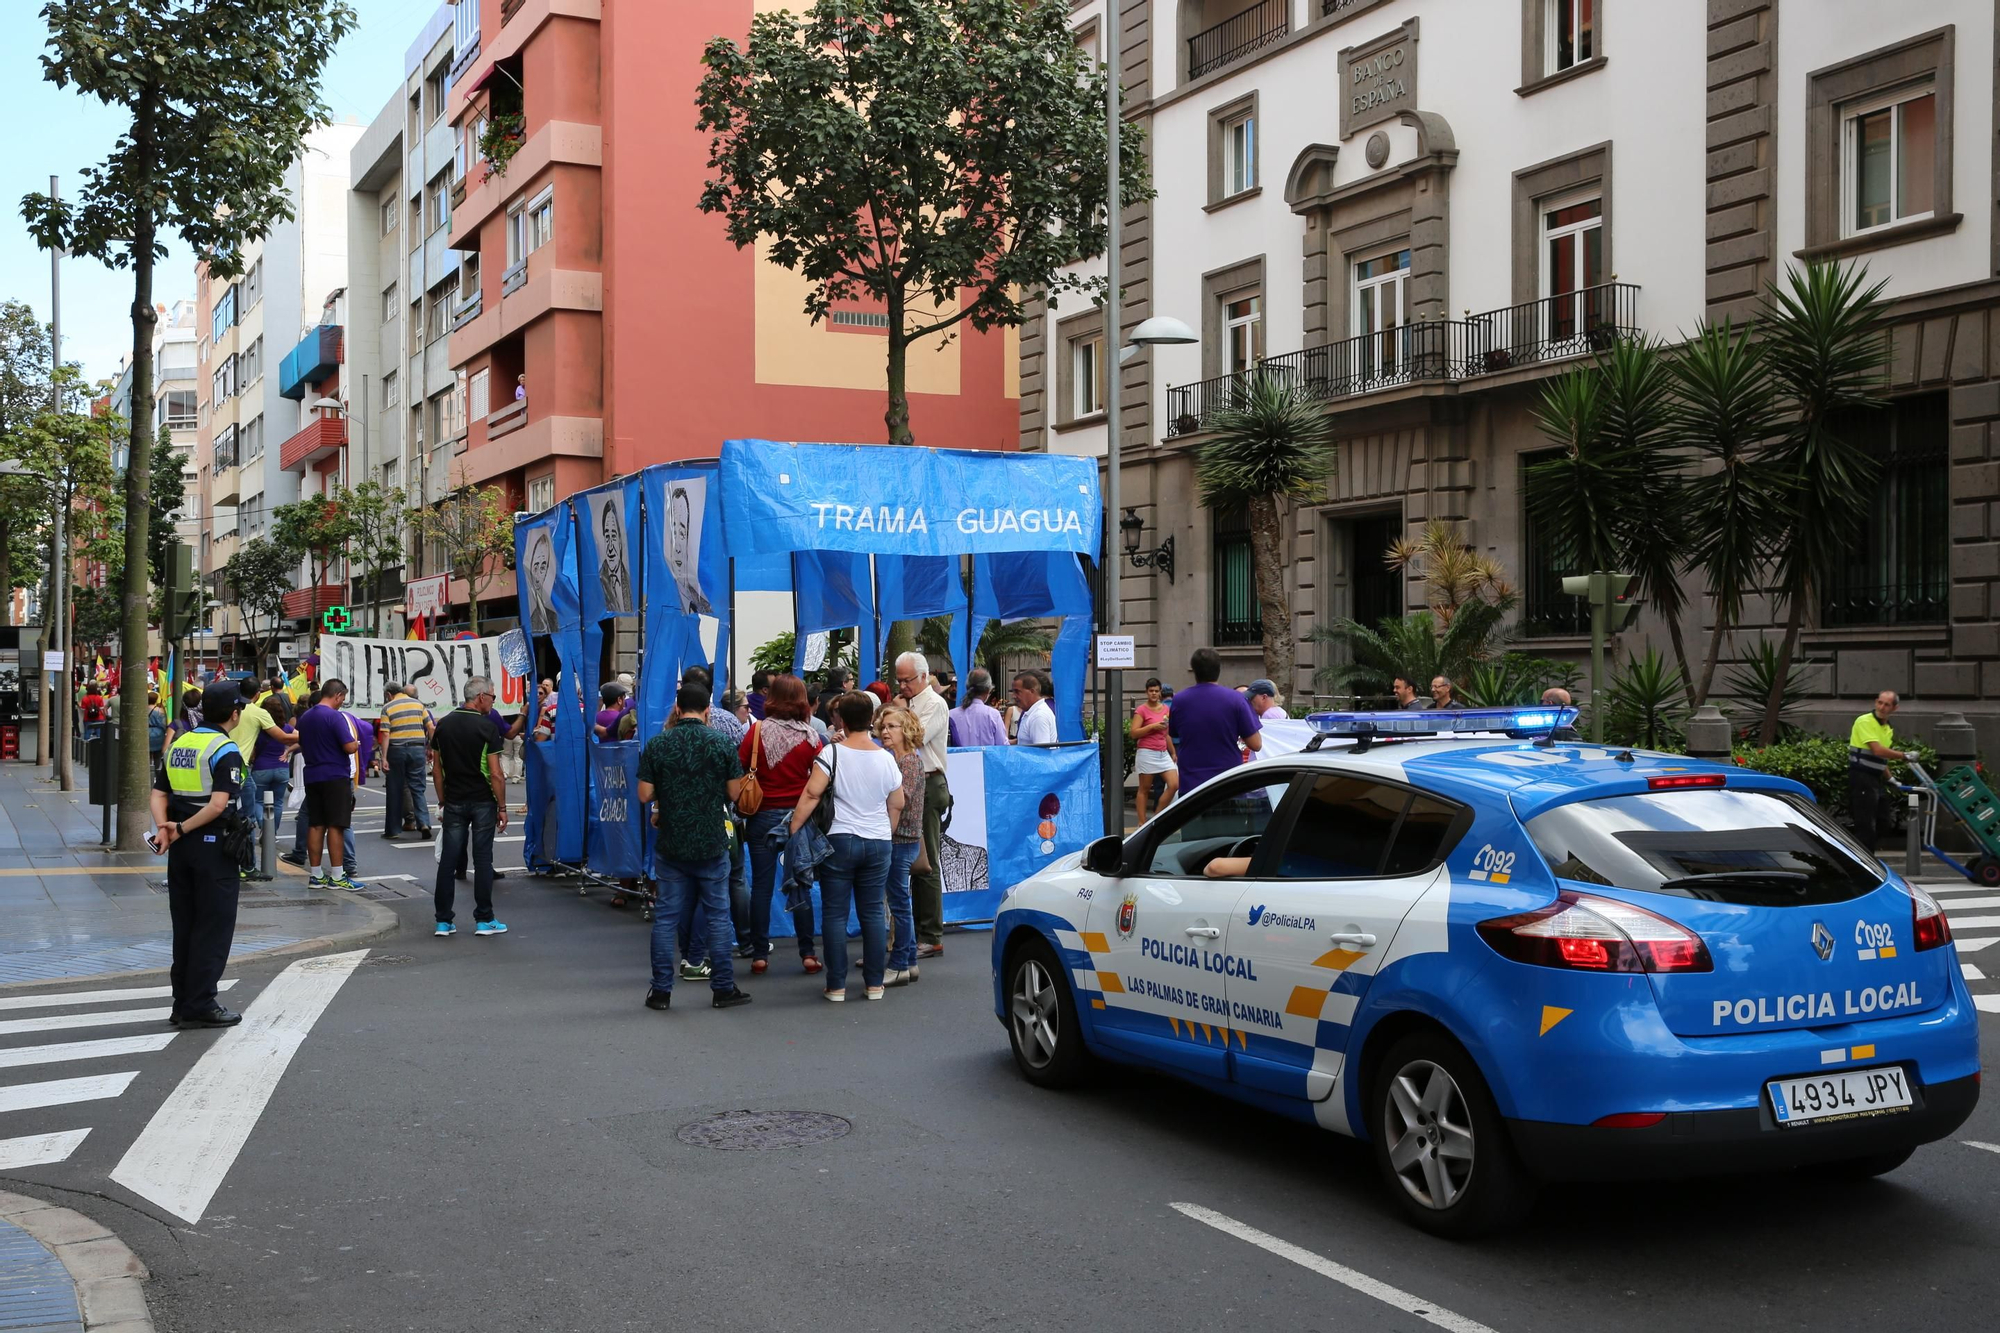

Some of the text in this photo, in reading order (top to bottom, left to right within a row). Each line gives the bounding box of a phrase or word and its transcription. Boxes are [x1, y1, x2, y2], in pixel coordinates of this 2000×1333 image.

[1354, 49, 1405, 85] BANCO
[1374, 75, 1384, 88] DE
[1353, 79, 1406, 115] ESPAÑA
[810, 503, 1082, 534] TRAMA GUAGUA
[170, 757, 195, 768] LOCAL
[1484, 849, 1516, 874] 092
[1077, 888, 1093, 900] R49
[1261, 912, 1315, 931] @PoliciaLPA
[1865, 923, 1894, 948] 092
[1141, 937, 1257, 981] POLICIA LOCAL
[1127, 976, 1283, 1030] LAS PALMAS DE GRAN CANARIA
[1713, 981, 1922, 1026] POLICIA LOCAL
[1792, 1072, 1904, 1113] 4934 JPY
[1779, 1105, 1785, 1114] E
